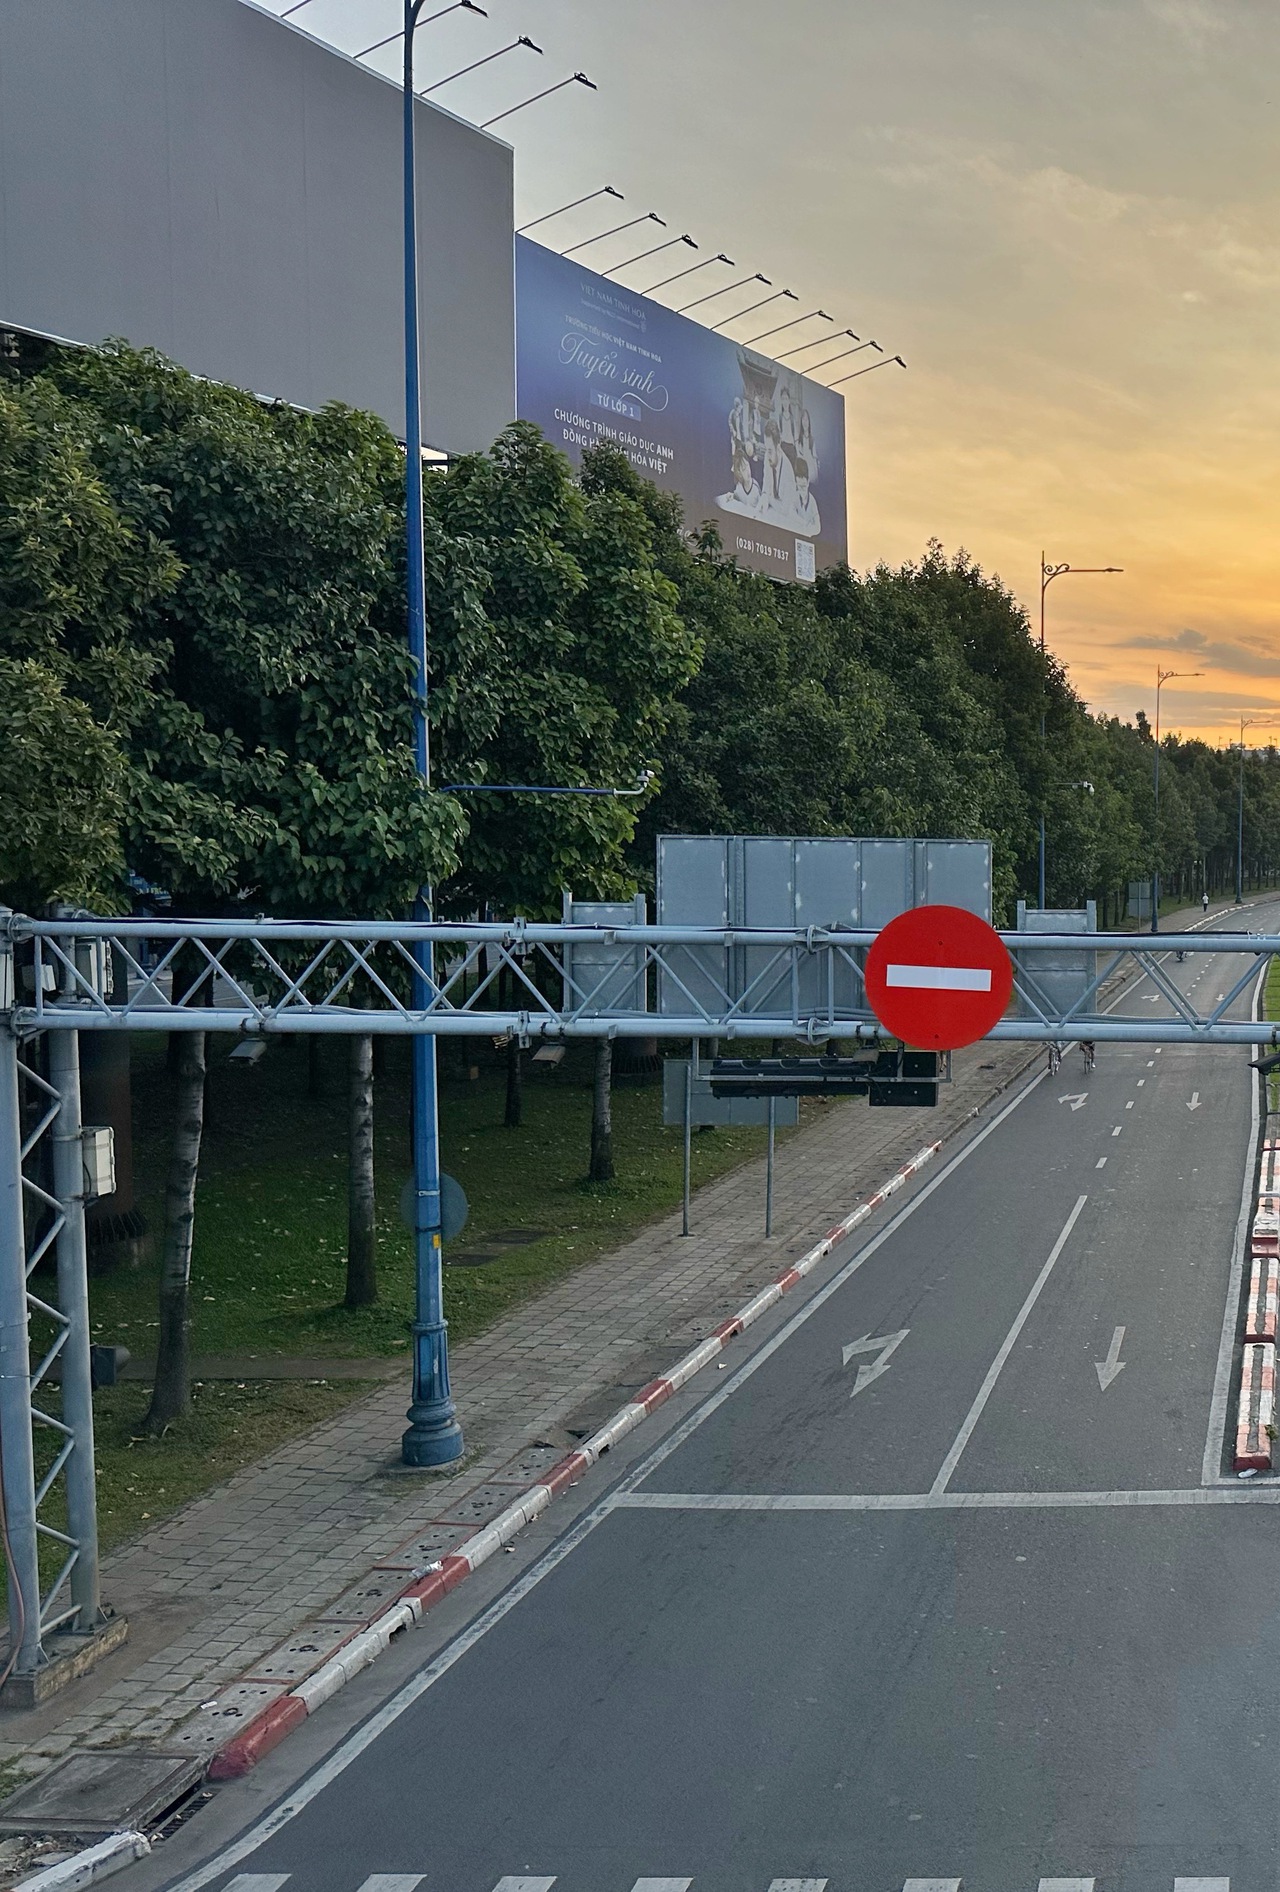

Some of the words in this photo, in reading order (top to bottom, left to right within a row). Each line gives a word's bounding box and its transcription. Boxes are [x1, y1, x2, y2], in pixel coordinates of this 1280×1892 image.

[558, 332, 619, 379] Tuyển
[598, 393, 610, 408] TỪ
[611, 397, 627, 414] LỚP
[629, 407, 635, 417] 1
[554, 408, 591, 430] CHƯƠNG
[592, 421, 617, 440] TRÌNH
[618, 431, 638, 447] GIÁO
[639, 438, 655, 454] DỤC
[656, 444, 674, 460] ANH
[563, 428, 588, 446] ĐỒNG
[631, 451, 648, 468] HÓA
[648, 457, 668, 475] VIỆT
[736, 536, 755, 553] (028)
[755, 542, 772, 557] 7019
[773, 547, 789, 561] 7837
